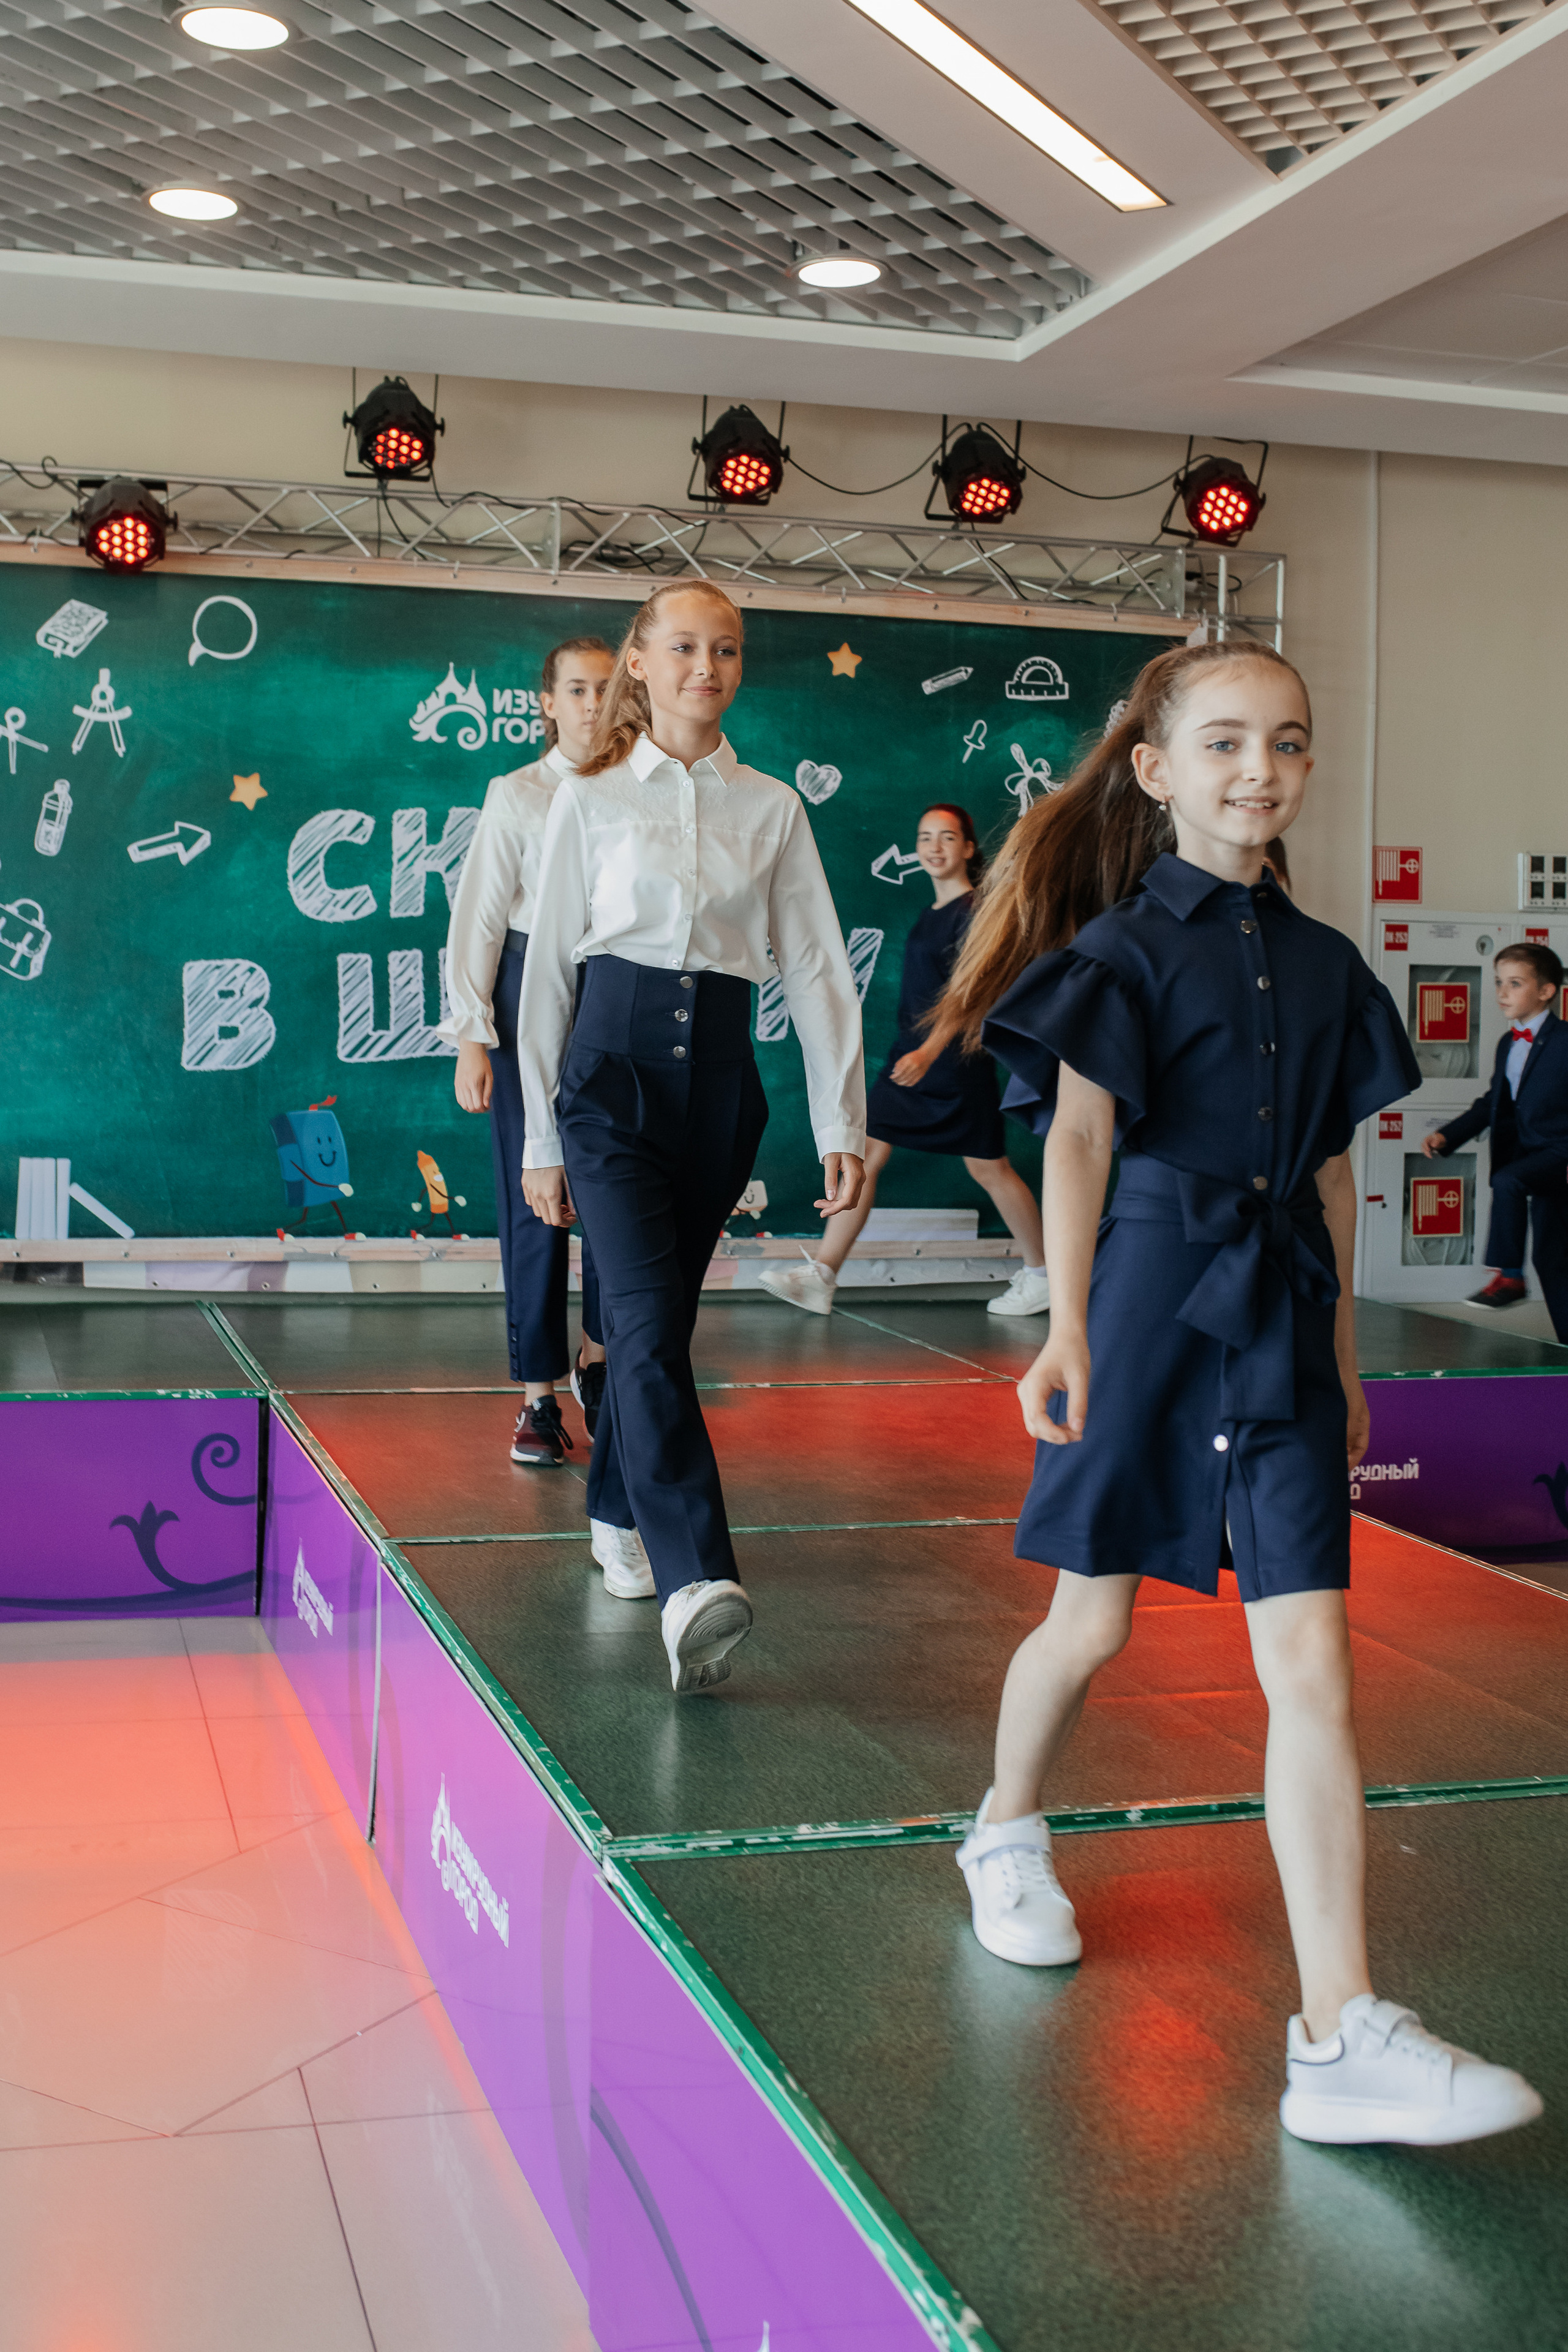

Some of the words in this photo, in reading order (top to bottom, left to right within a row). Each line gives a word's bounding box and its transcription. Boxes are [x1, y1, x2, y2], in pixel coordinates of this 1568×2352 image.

[492, 716, 546, 745] ГОР
[181, 958, 276, 1071] В
[1349, 1458, 1419, 1482] РУДНЫЙ
